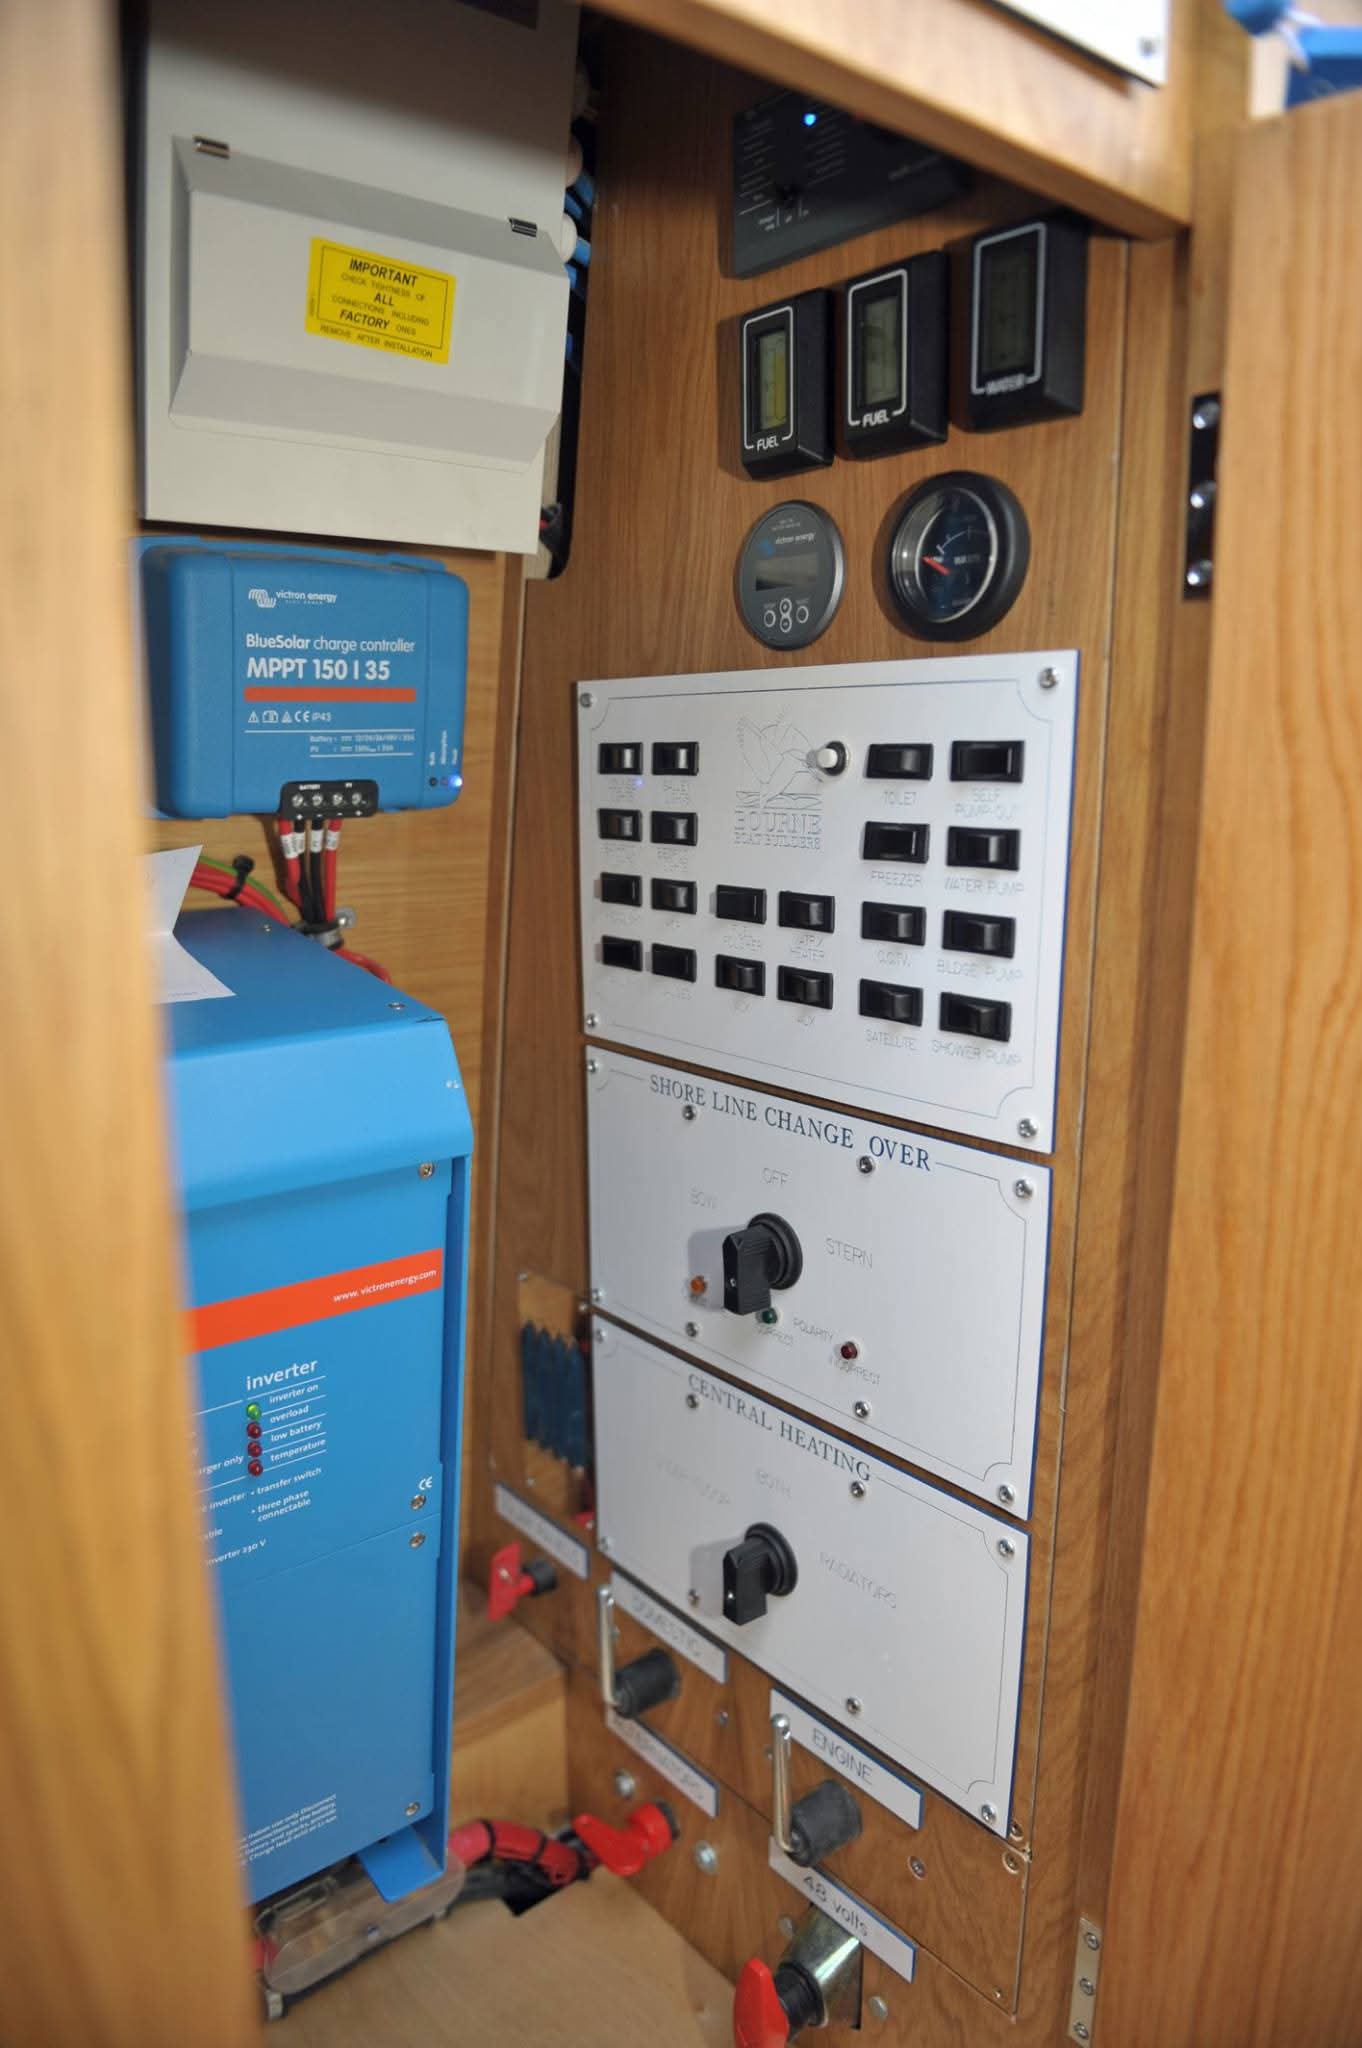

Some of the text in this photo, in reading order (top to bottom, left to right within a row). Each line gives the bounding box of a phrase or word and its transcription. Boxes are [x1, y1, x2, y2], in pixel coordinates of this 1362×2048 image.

[349, 257, 419, 288] IMPORTANT
[373, 292, 394, 307] ALL
[339, 308, 391, 331] FACTORY
[383, 339, 433, 359] INSTALLATION
[862, 409, 890, 428] FUEL
[756, 436, 780, 451] FUEL
[275, 589, 306, 600] victron
[307, 592, 337, 604] energy
[245, 633, 416, 655] BlueSolar charge controller
[246, 657, 307, 679] MPPT
[312, 658, 348, 681] 150
[364, 660, 391, 681] 35
[650, 1074, 931, 1171] SHORE LINE CHANGE OVER
[826, 1238, 873, 1269] STERN
[361, 1270, 437, 1296] victronenergy.com
[246, 1360, 318, 1391] inverter
[270, 1384, 319, 1404] inverter on
[270, 1405, 309, 1424] overload
[271, 1422, 322, 1443] low battery
[689, 1373, 772, 1431] CENTRAL
[779, 1420, 871, 1482] HEATING
[223, 1455, 245, 1467] only
[270, 1440, 326, 1463] temperature
[257, 1467, 322, 1495] transfer switch
[209, 1492, 246, 1511] inverter
[257, 1490, 310, 1513] three phase
[257, 1499, 311, 1522] connectable
[812, 1728, 873, 1786] ENGINE
[803, 1876, 868, 1937] 48 volts
